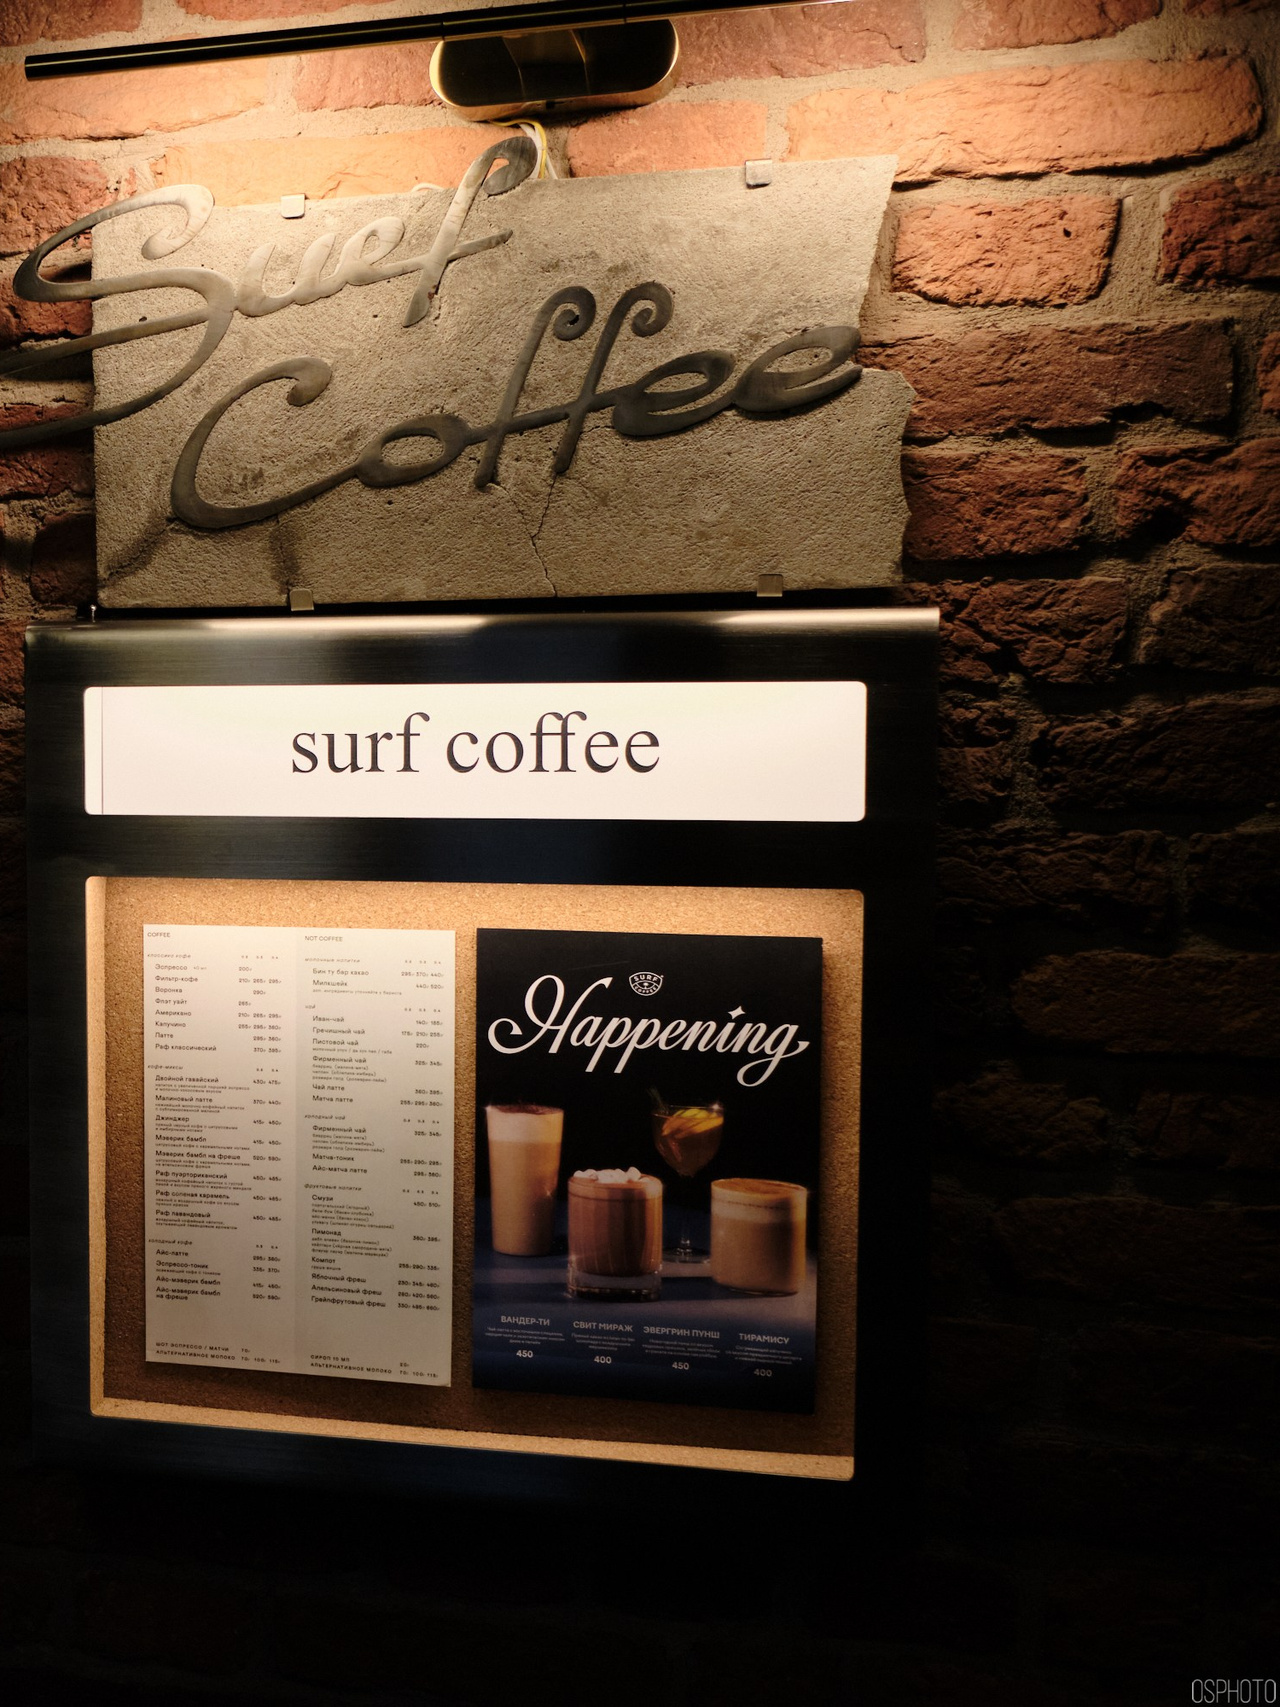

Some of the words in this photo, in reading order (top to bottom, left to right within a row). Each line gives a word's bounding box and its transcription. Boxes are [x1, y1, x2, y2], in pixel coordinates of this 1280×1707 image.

[170, 281, 863, 529] Coffee
[291, 711, 430, 774] surf
[446, 711, 661, 774] coffee
[488, 974, 810, 1087] Happening
[313, 1165, 348, 1173] Айс-матча
[312, 1256, 335, 1264] Компот
[156, 1261, 208, 1269] Эспрессо-тоник
[156, 1276, 198, 1284] Айс-мэверик
[312, 1273, 344, 1281] Яблочный
[312, 1285, 360, 1294] Апельсиновый
[362, 1288, 382, 1296] фреш
[312, 1296, 364, 1305] Грейпфрутовый
[501, 1316, 550, 1326] ВАНДЕР-ТИ
[573, 1321, 597, 1329] СВИТ
[598, 1323, 633, 1332] МИРАЖ
[643, 1326, 690, 1337] ЭВЕРГРИН
[692, 1330, 720, 1339] ПУНШ
[739, 1333, 790, 1344] ТИРАМИСУ
[156, 1350, 208, 1358] АЛЬТЕРНАТИВНОЕ
[516, 1350, 534, 1358] 450
[594, 1356, 612, 1364] 400
[310, 1362, 364, 1371] АЛЬТЕРНАТИВНОЕ
[672, 1362, 689, 1370] 450
[754, 1369, 772, 1377] 400
